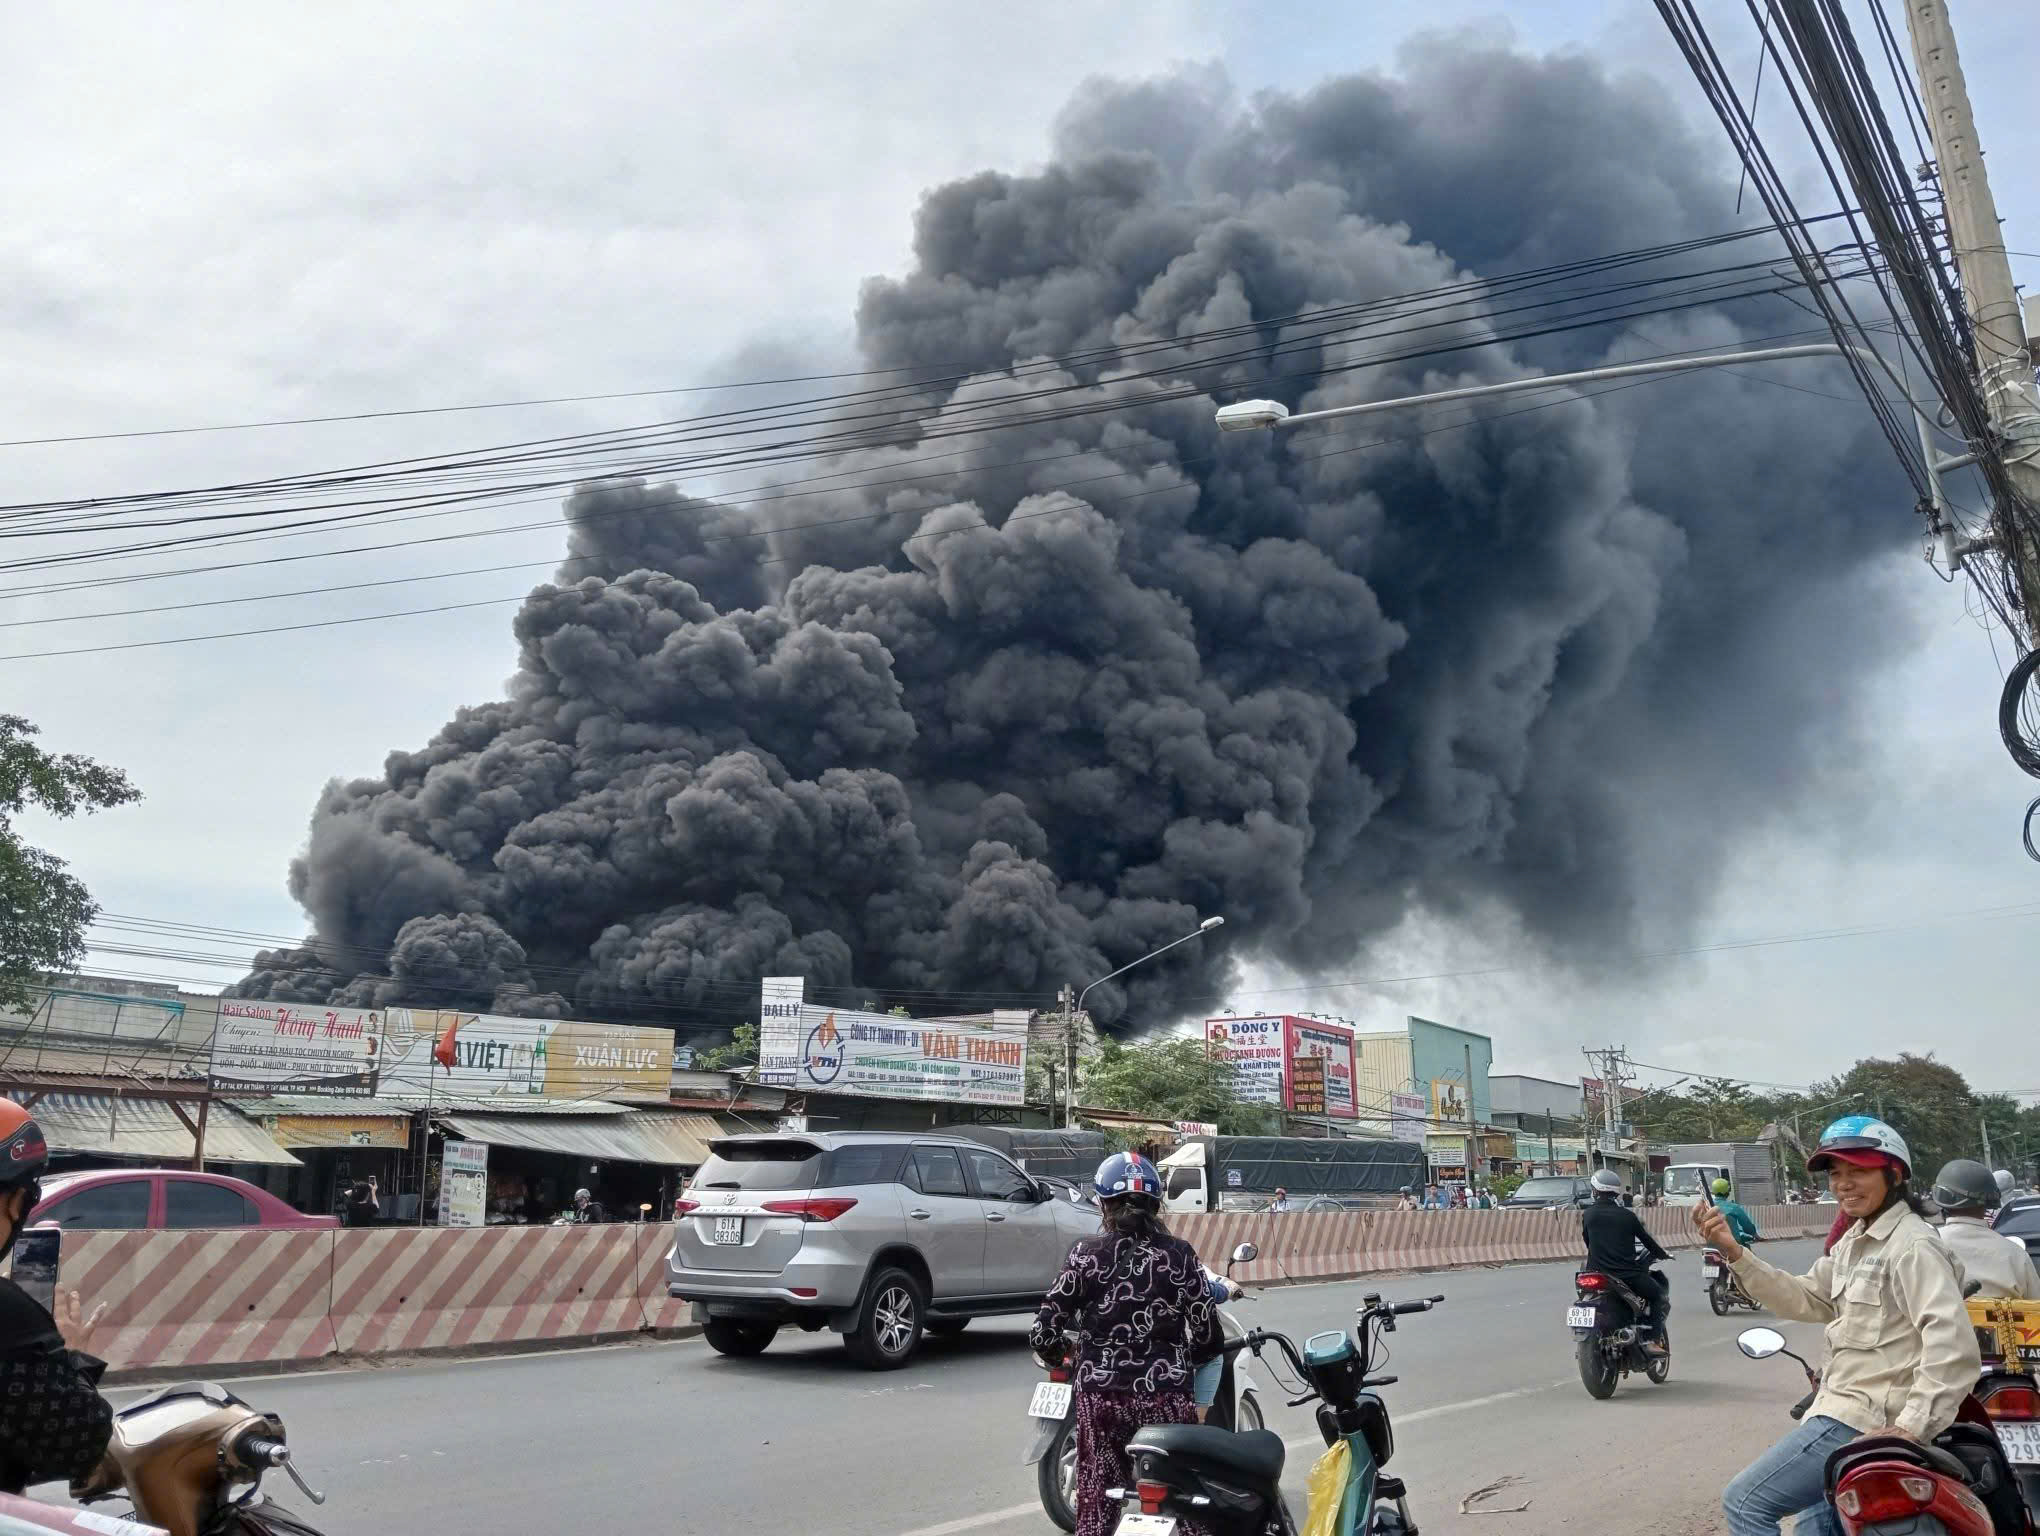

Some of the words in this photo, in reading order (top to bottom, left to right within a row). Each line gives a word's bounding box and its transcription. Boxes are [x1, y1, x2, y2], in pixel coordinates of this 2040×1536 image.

[223, 1004, 243, 1017] Hair
[245, 1005, 271, 1020] Salon
[1232, 1022, 1268, 1034] ĐÔNG
[1272, 1022, 1280, 1032] Y
[922, 1027, 958, 1059] VĂN
[468, 1039, 509, 1072] VIỆT
[575, 1042, 622, 1068] XUÂN
[626, 1048, 659, 1074] LỰC
[722, 1218, 735, 1230] 61A
[1040, 1386, 1066, 1400] 61-G1
[1033, 1400, 1066, 1416] 446.73
